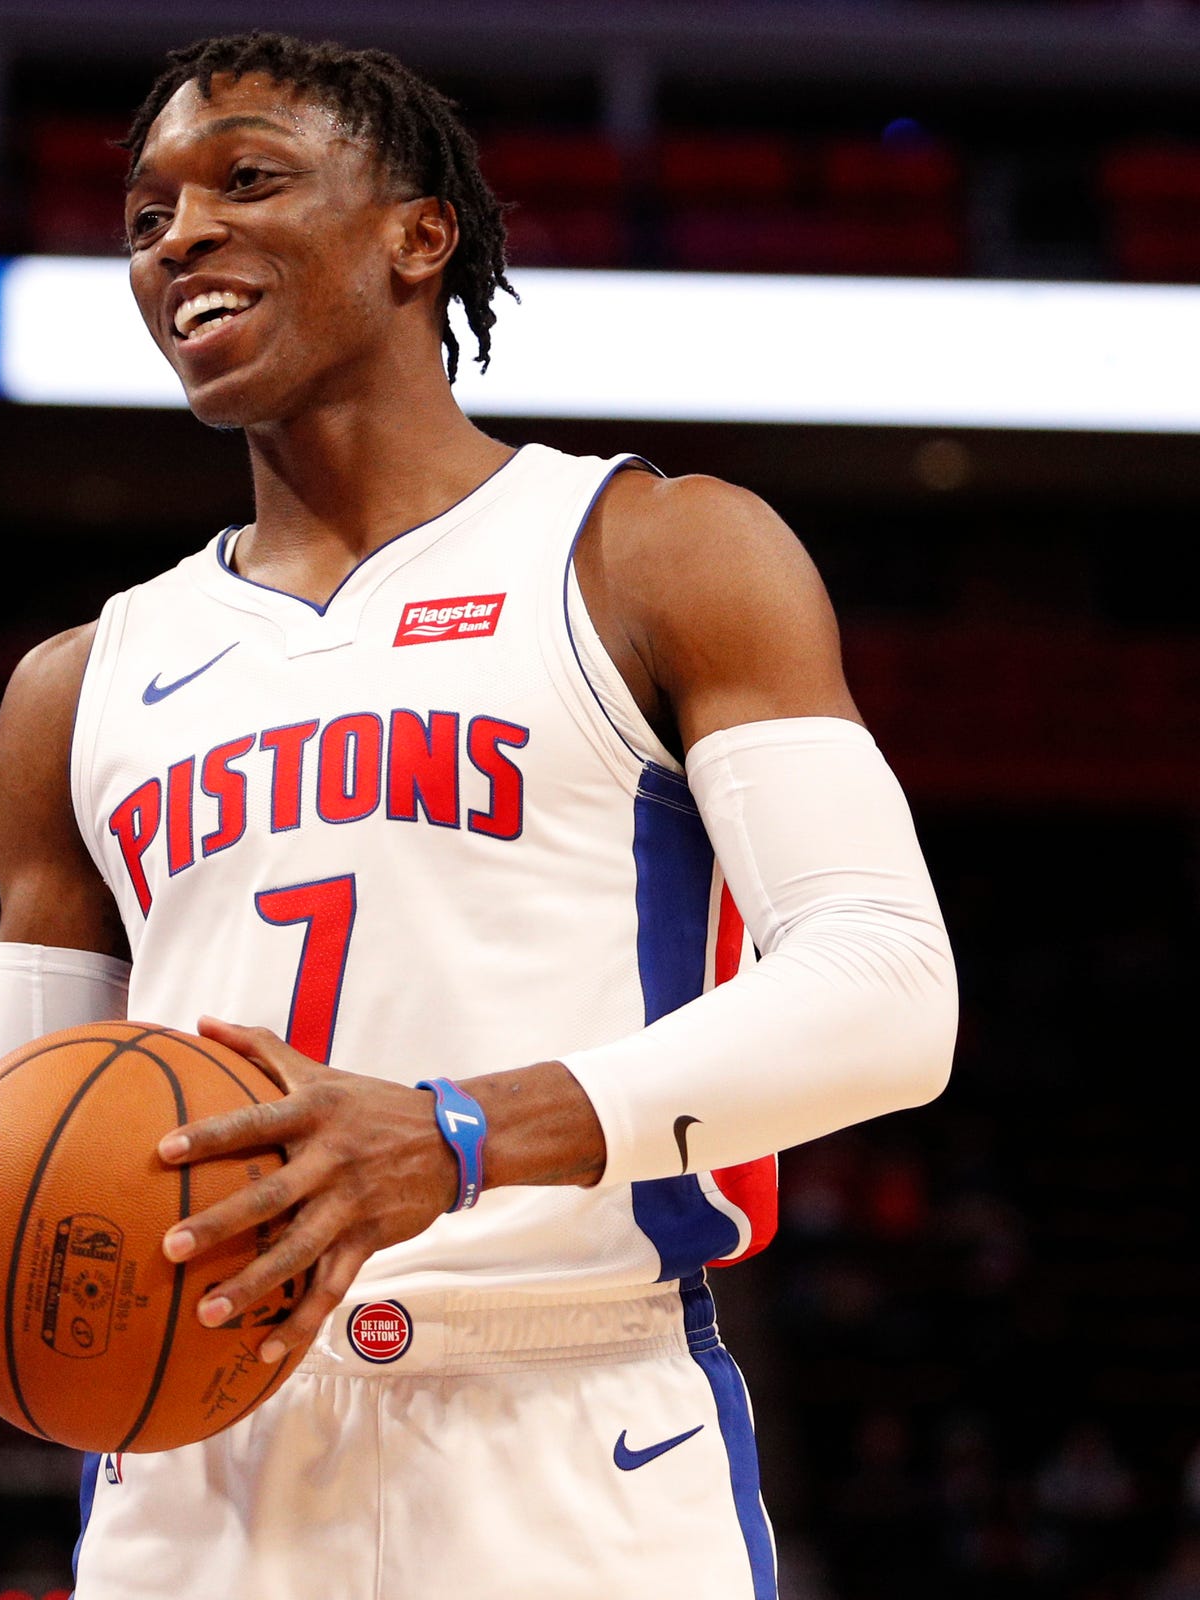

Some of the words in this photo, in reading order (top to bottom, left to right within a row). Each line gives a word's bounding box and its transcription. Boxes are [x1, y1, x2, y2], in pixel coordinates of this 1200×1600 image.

[405, 602, 498, 625] Flagstar
[457, 620, 491, 633] Bank
[108, 708, 530, 921] PISTONS
[253, 872, 358, 1067] 7
[444, 1109, 479, 1133] 7
[360, 1320, 400, 1331] DETROIT
[360, 1331, 400, 1342] PISTONS
